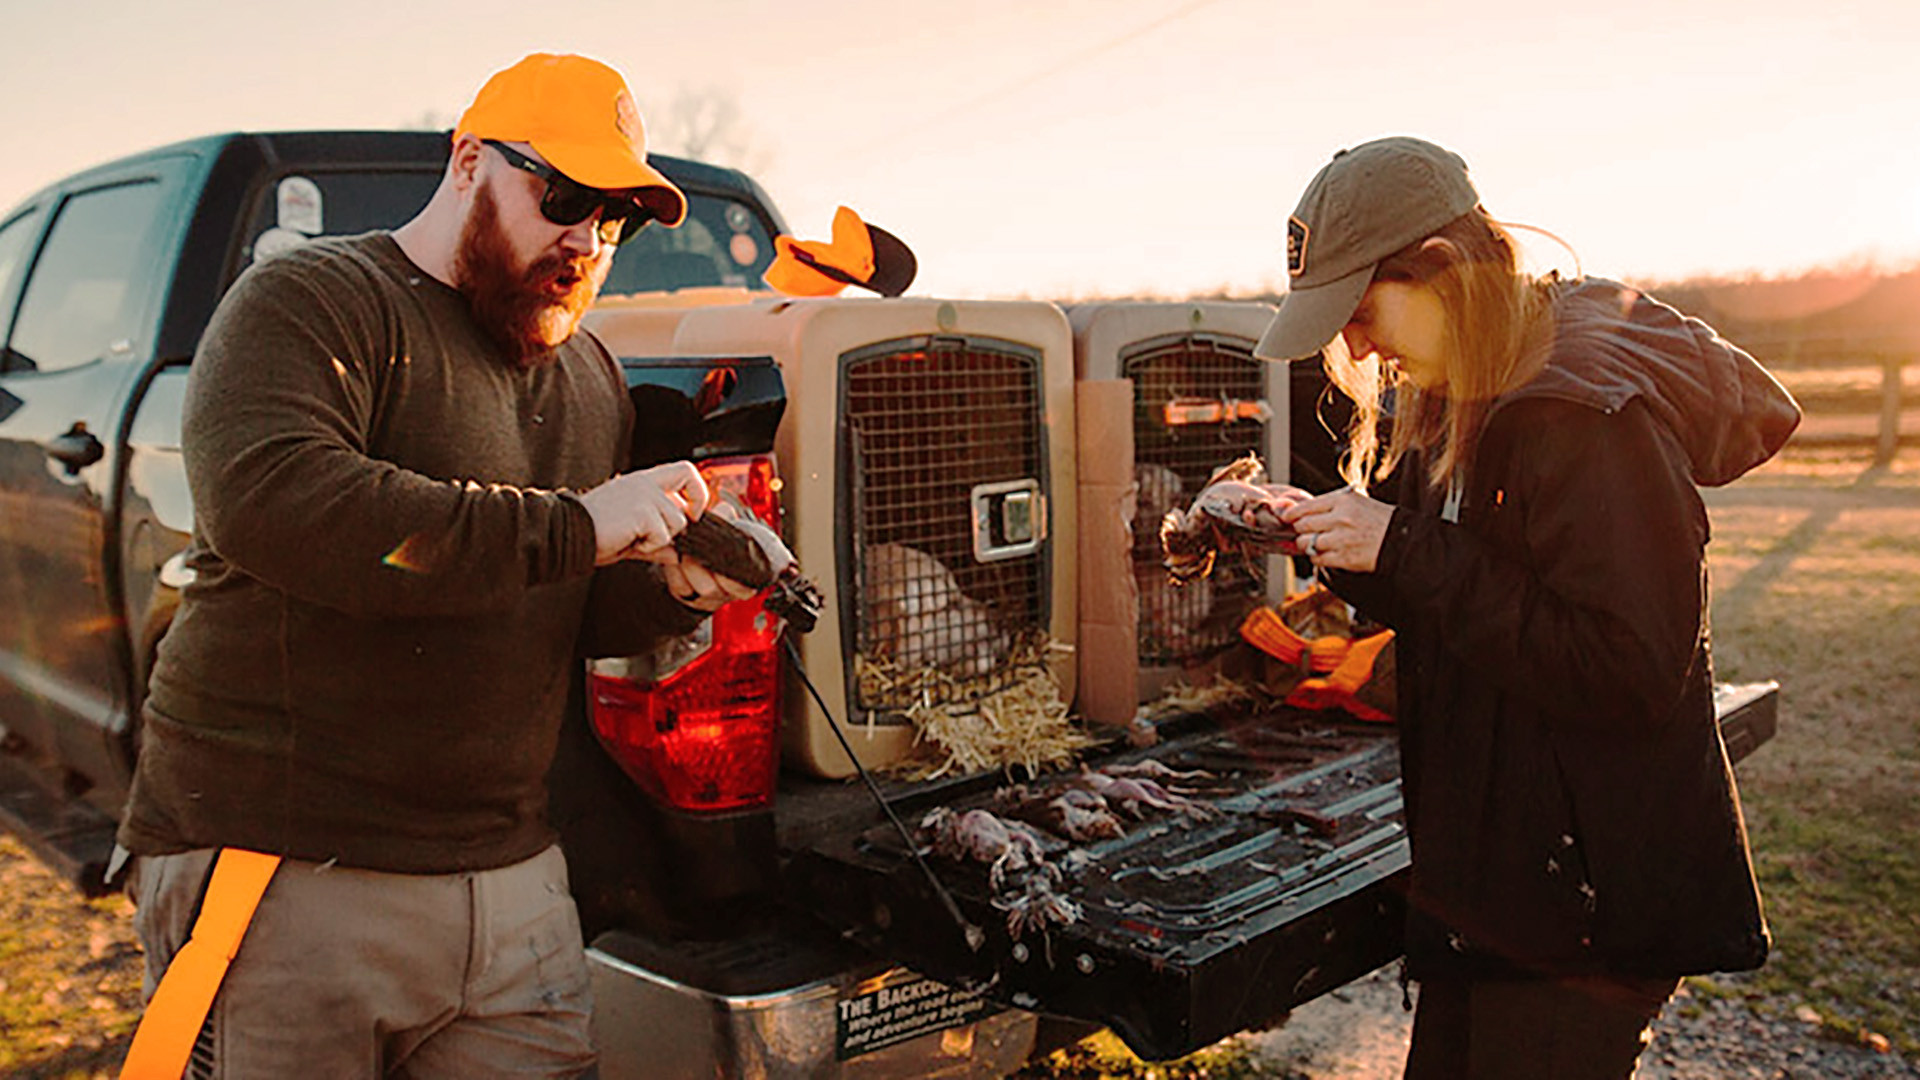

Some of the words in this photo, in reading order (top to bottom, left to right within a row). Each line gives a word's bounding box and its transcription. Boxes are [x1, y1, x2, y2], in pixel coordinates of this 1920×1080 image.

[838, 996, 873, 1021] THE
[894, 1003, 916, 1020] the
[917, 993, 949, 1013] road
[844, 1028, 872, 1049] and
[871, 1011, 938, 1040] adventure
